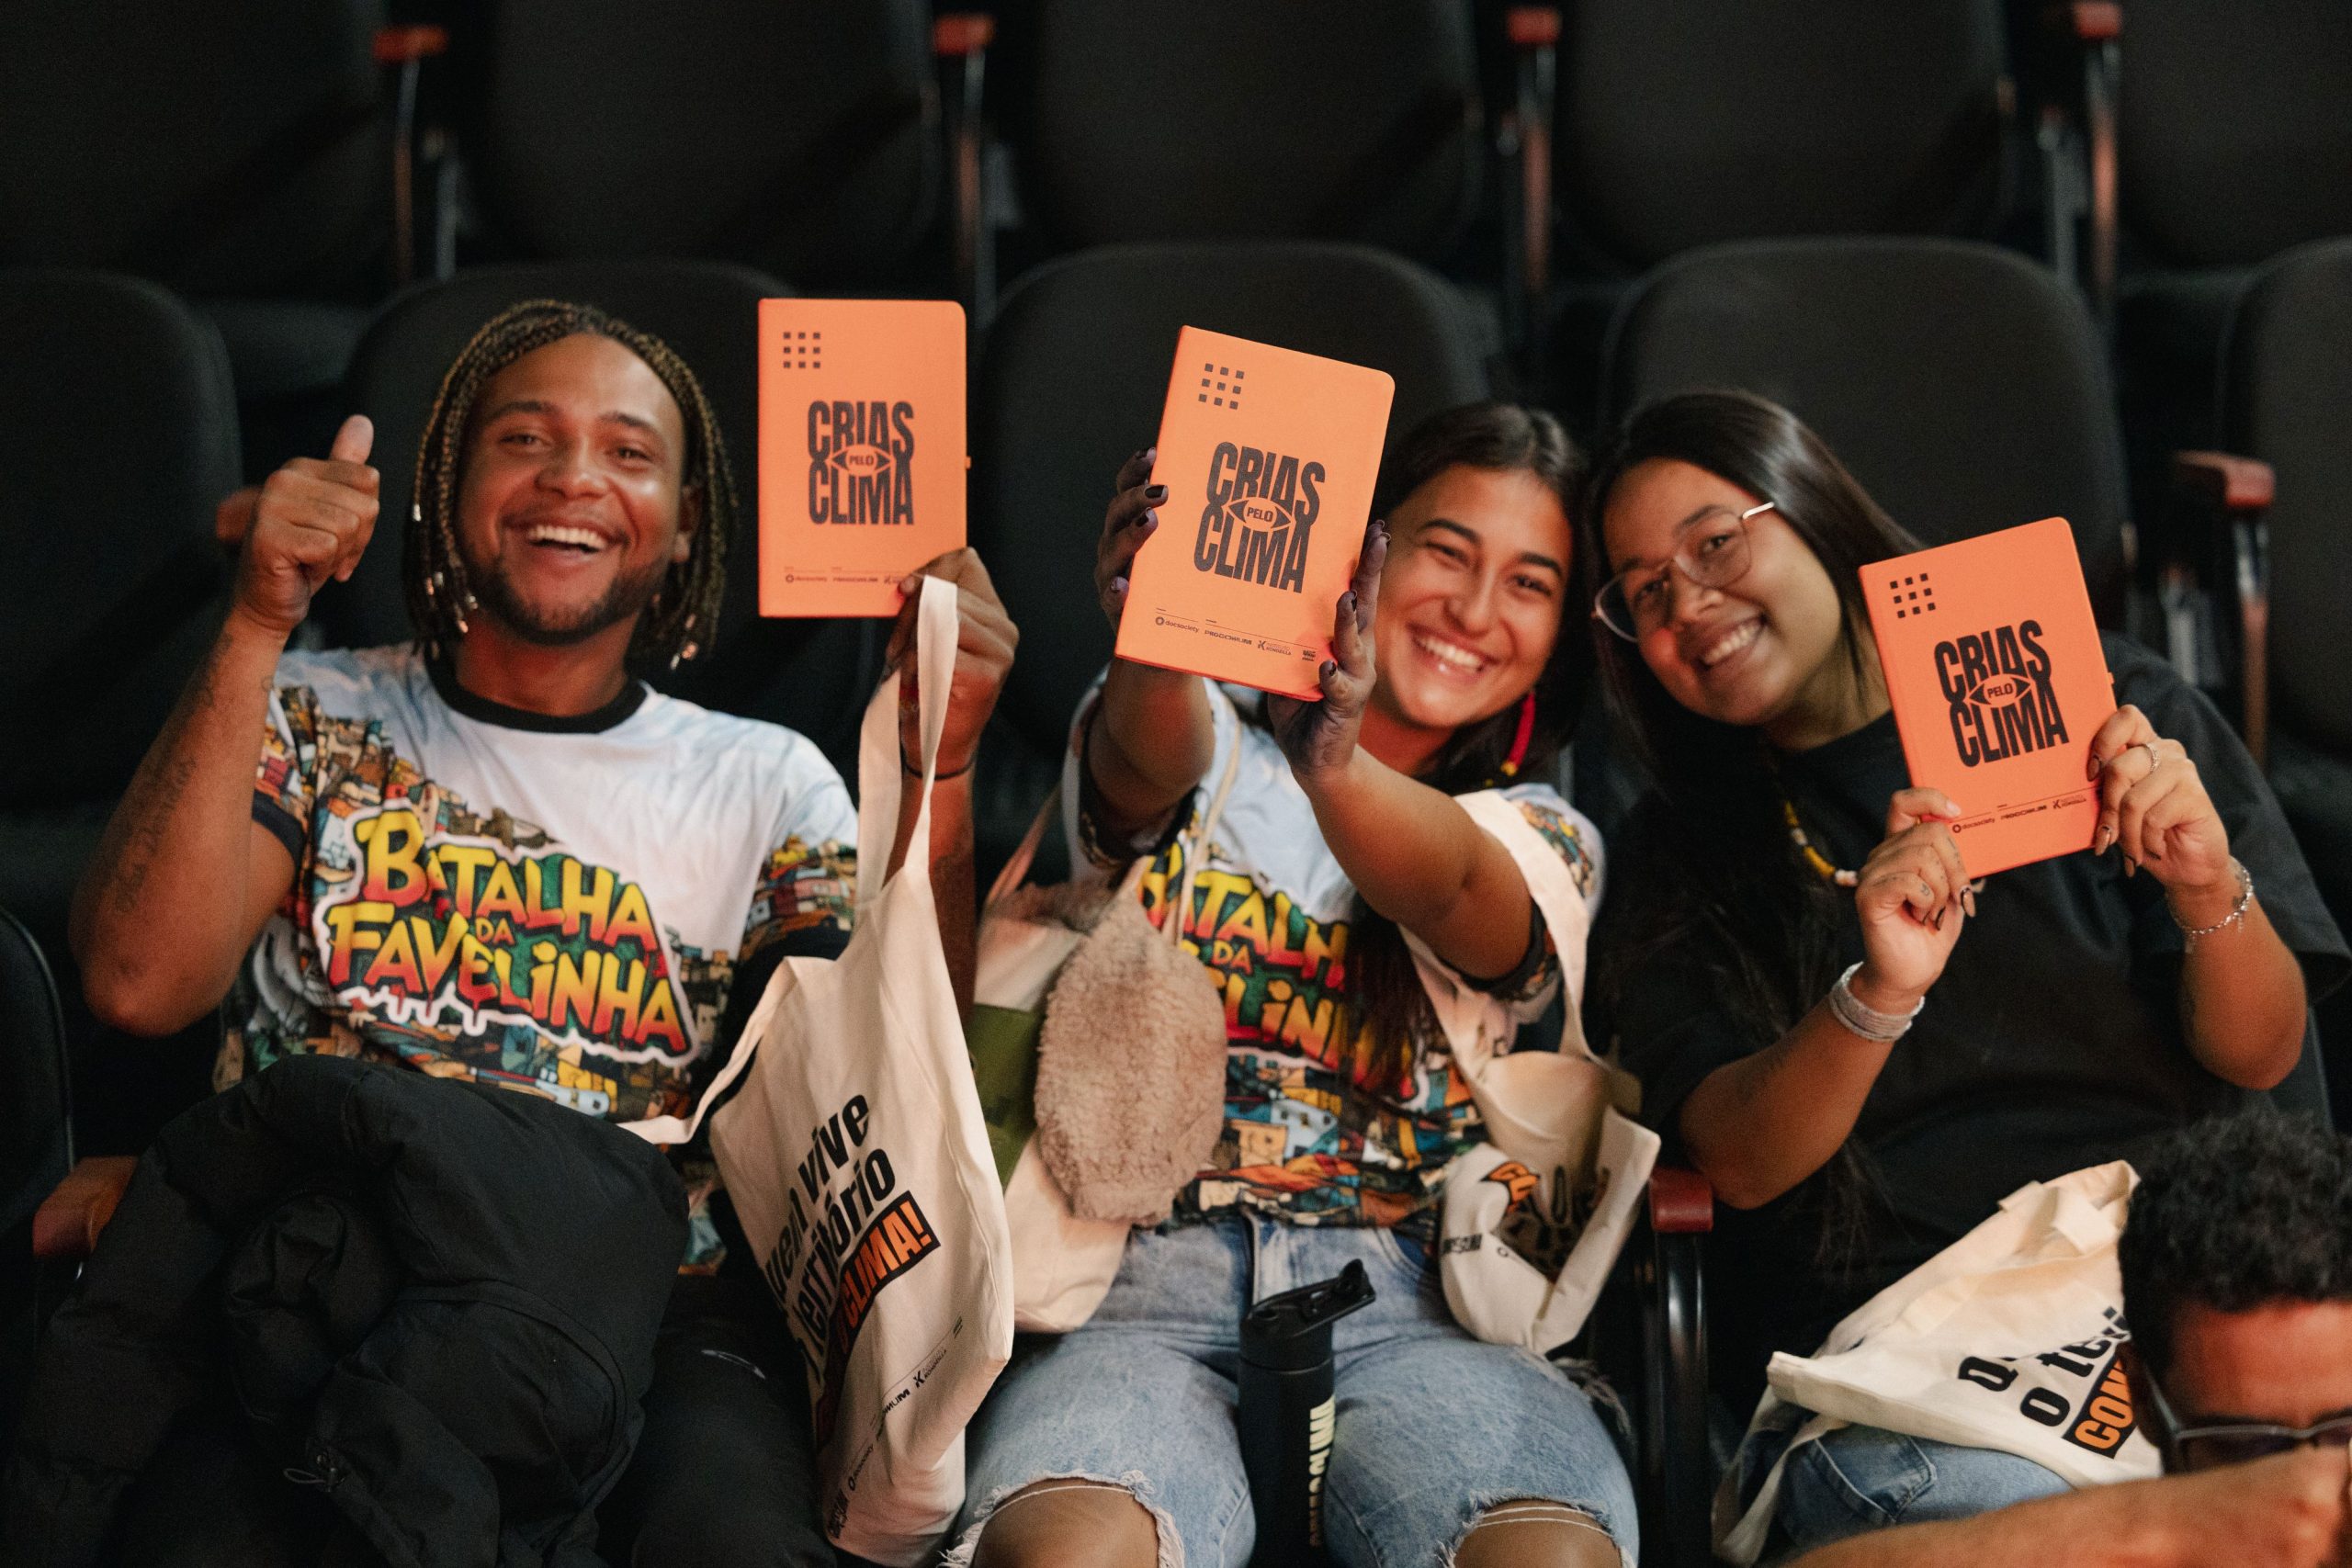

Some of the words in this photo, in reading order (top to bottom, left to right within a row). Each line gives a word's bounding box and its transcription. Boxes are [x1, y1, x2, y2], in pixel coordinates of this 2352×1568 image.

[808, 400, 914, 460] CRIAS
[849, 454, 874, 467] PELO
[808, 459, 915, 525] CLIMA
[1206, 442, 1326, 525] CRIAS
[1246, 505, 1274, 523] PELO
[1194, 502, 1313, 594] CLIMA
[1934, 619, 2052, 704] CRIAS
[1987, 682, 2013, 698] PELO
[1950, 679, 2070, 768] CLIMA
[355, 809, 659, 953] BATALHA
[475, 917, 515, 945] DA
[1210, 940, 1252, 975] DA
[797, 1094, 869, 1204] vive
